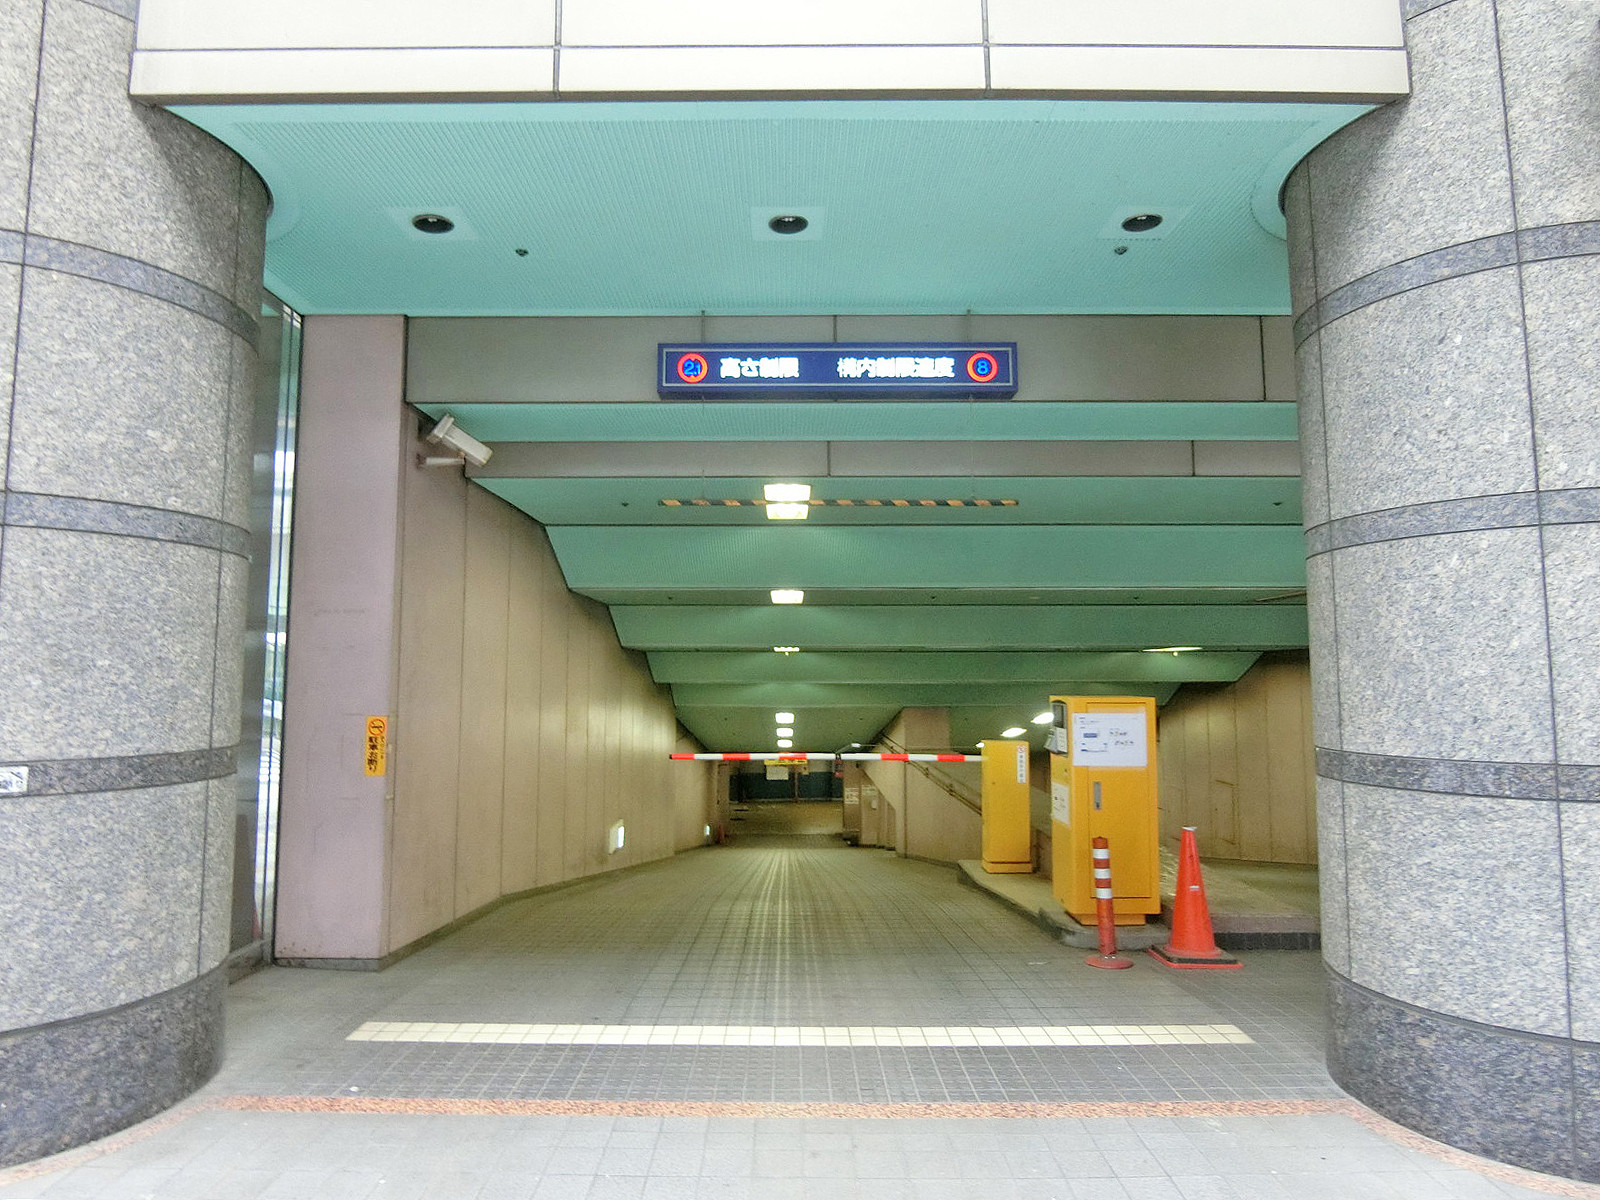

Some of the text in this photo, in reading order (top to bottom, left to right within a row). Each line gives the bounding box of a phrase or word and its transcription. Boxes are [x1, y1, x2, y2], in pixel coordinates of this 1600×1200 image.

[719, 357, 800, 378] 高さ制限
[976, 360, 989, 375] 8
